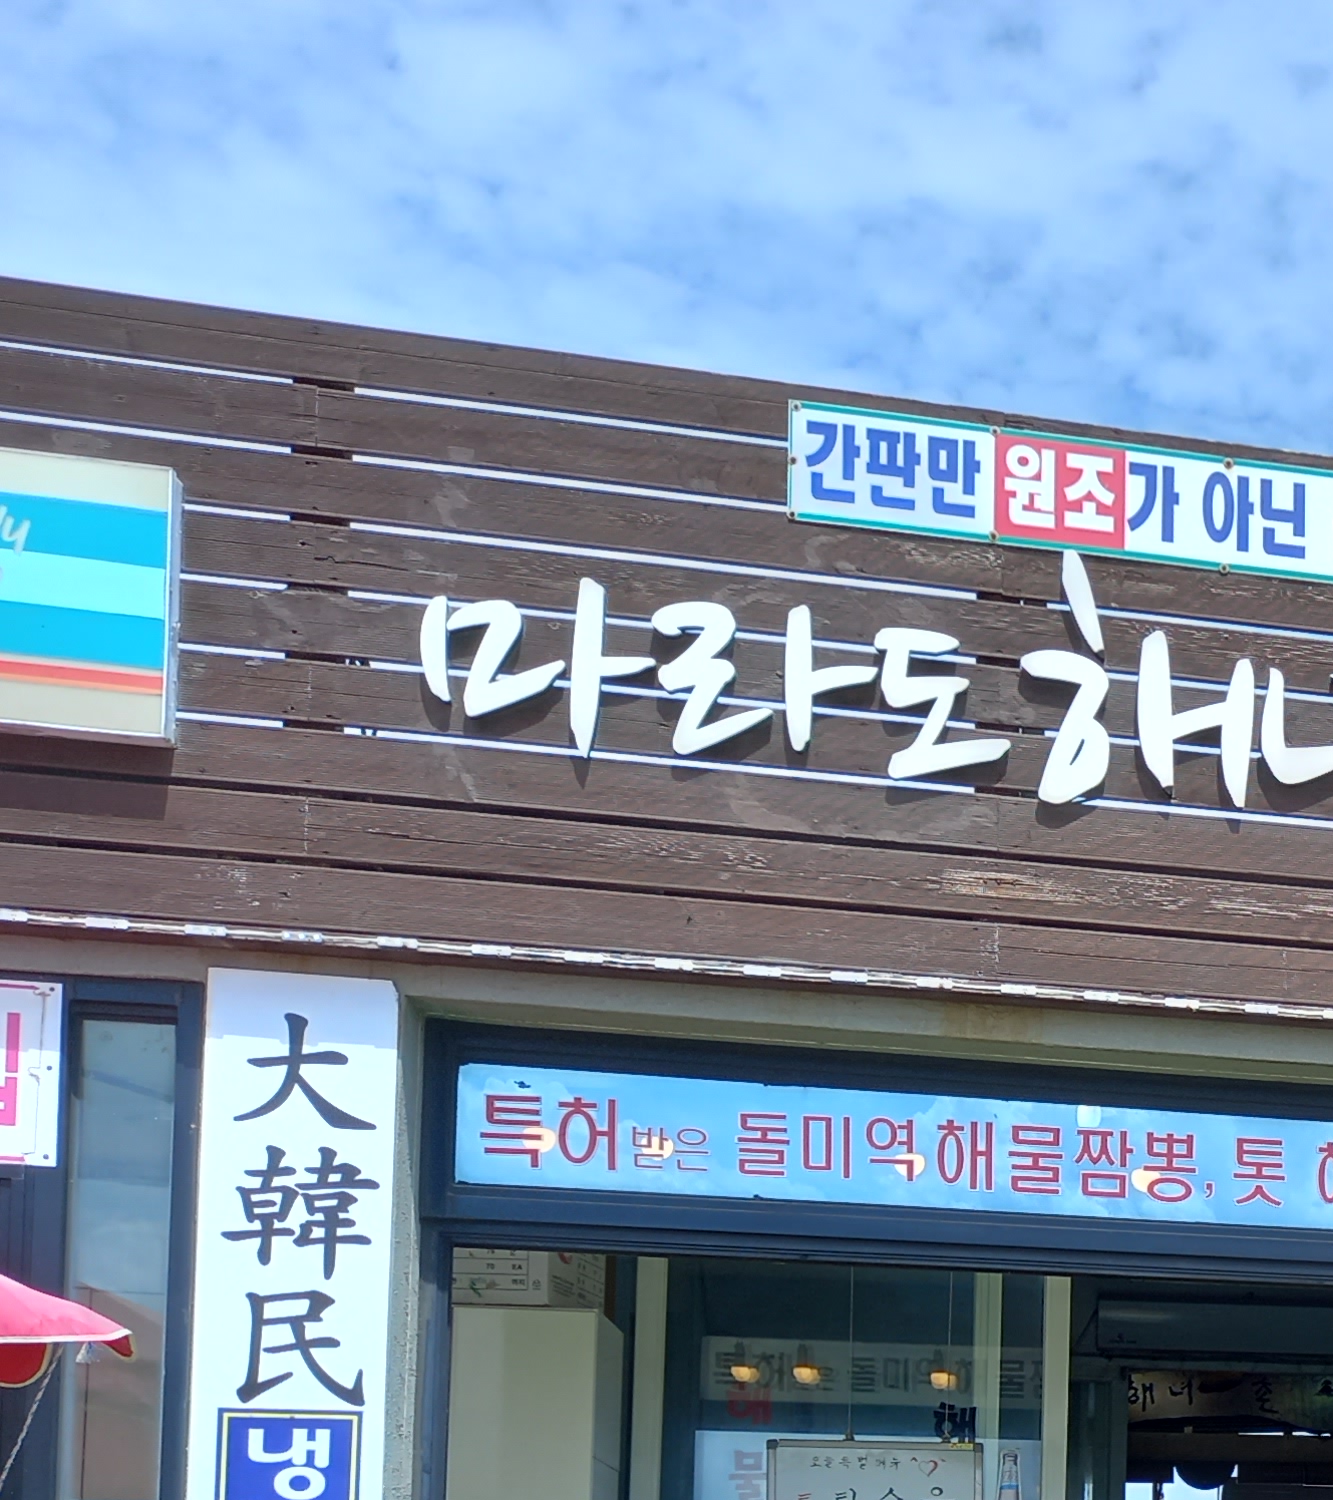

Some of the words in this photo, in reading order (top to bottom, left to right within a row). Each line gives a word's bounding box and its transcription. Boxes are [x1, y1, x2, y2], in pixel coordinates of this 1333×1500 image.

[804, 421, 982, 519] 간판만
[1002, 441, 1180, 544] 원조가
[1201, 469, 1308, 561] 아닌
